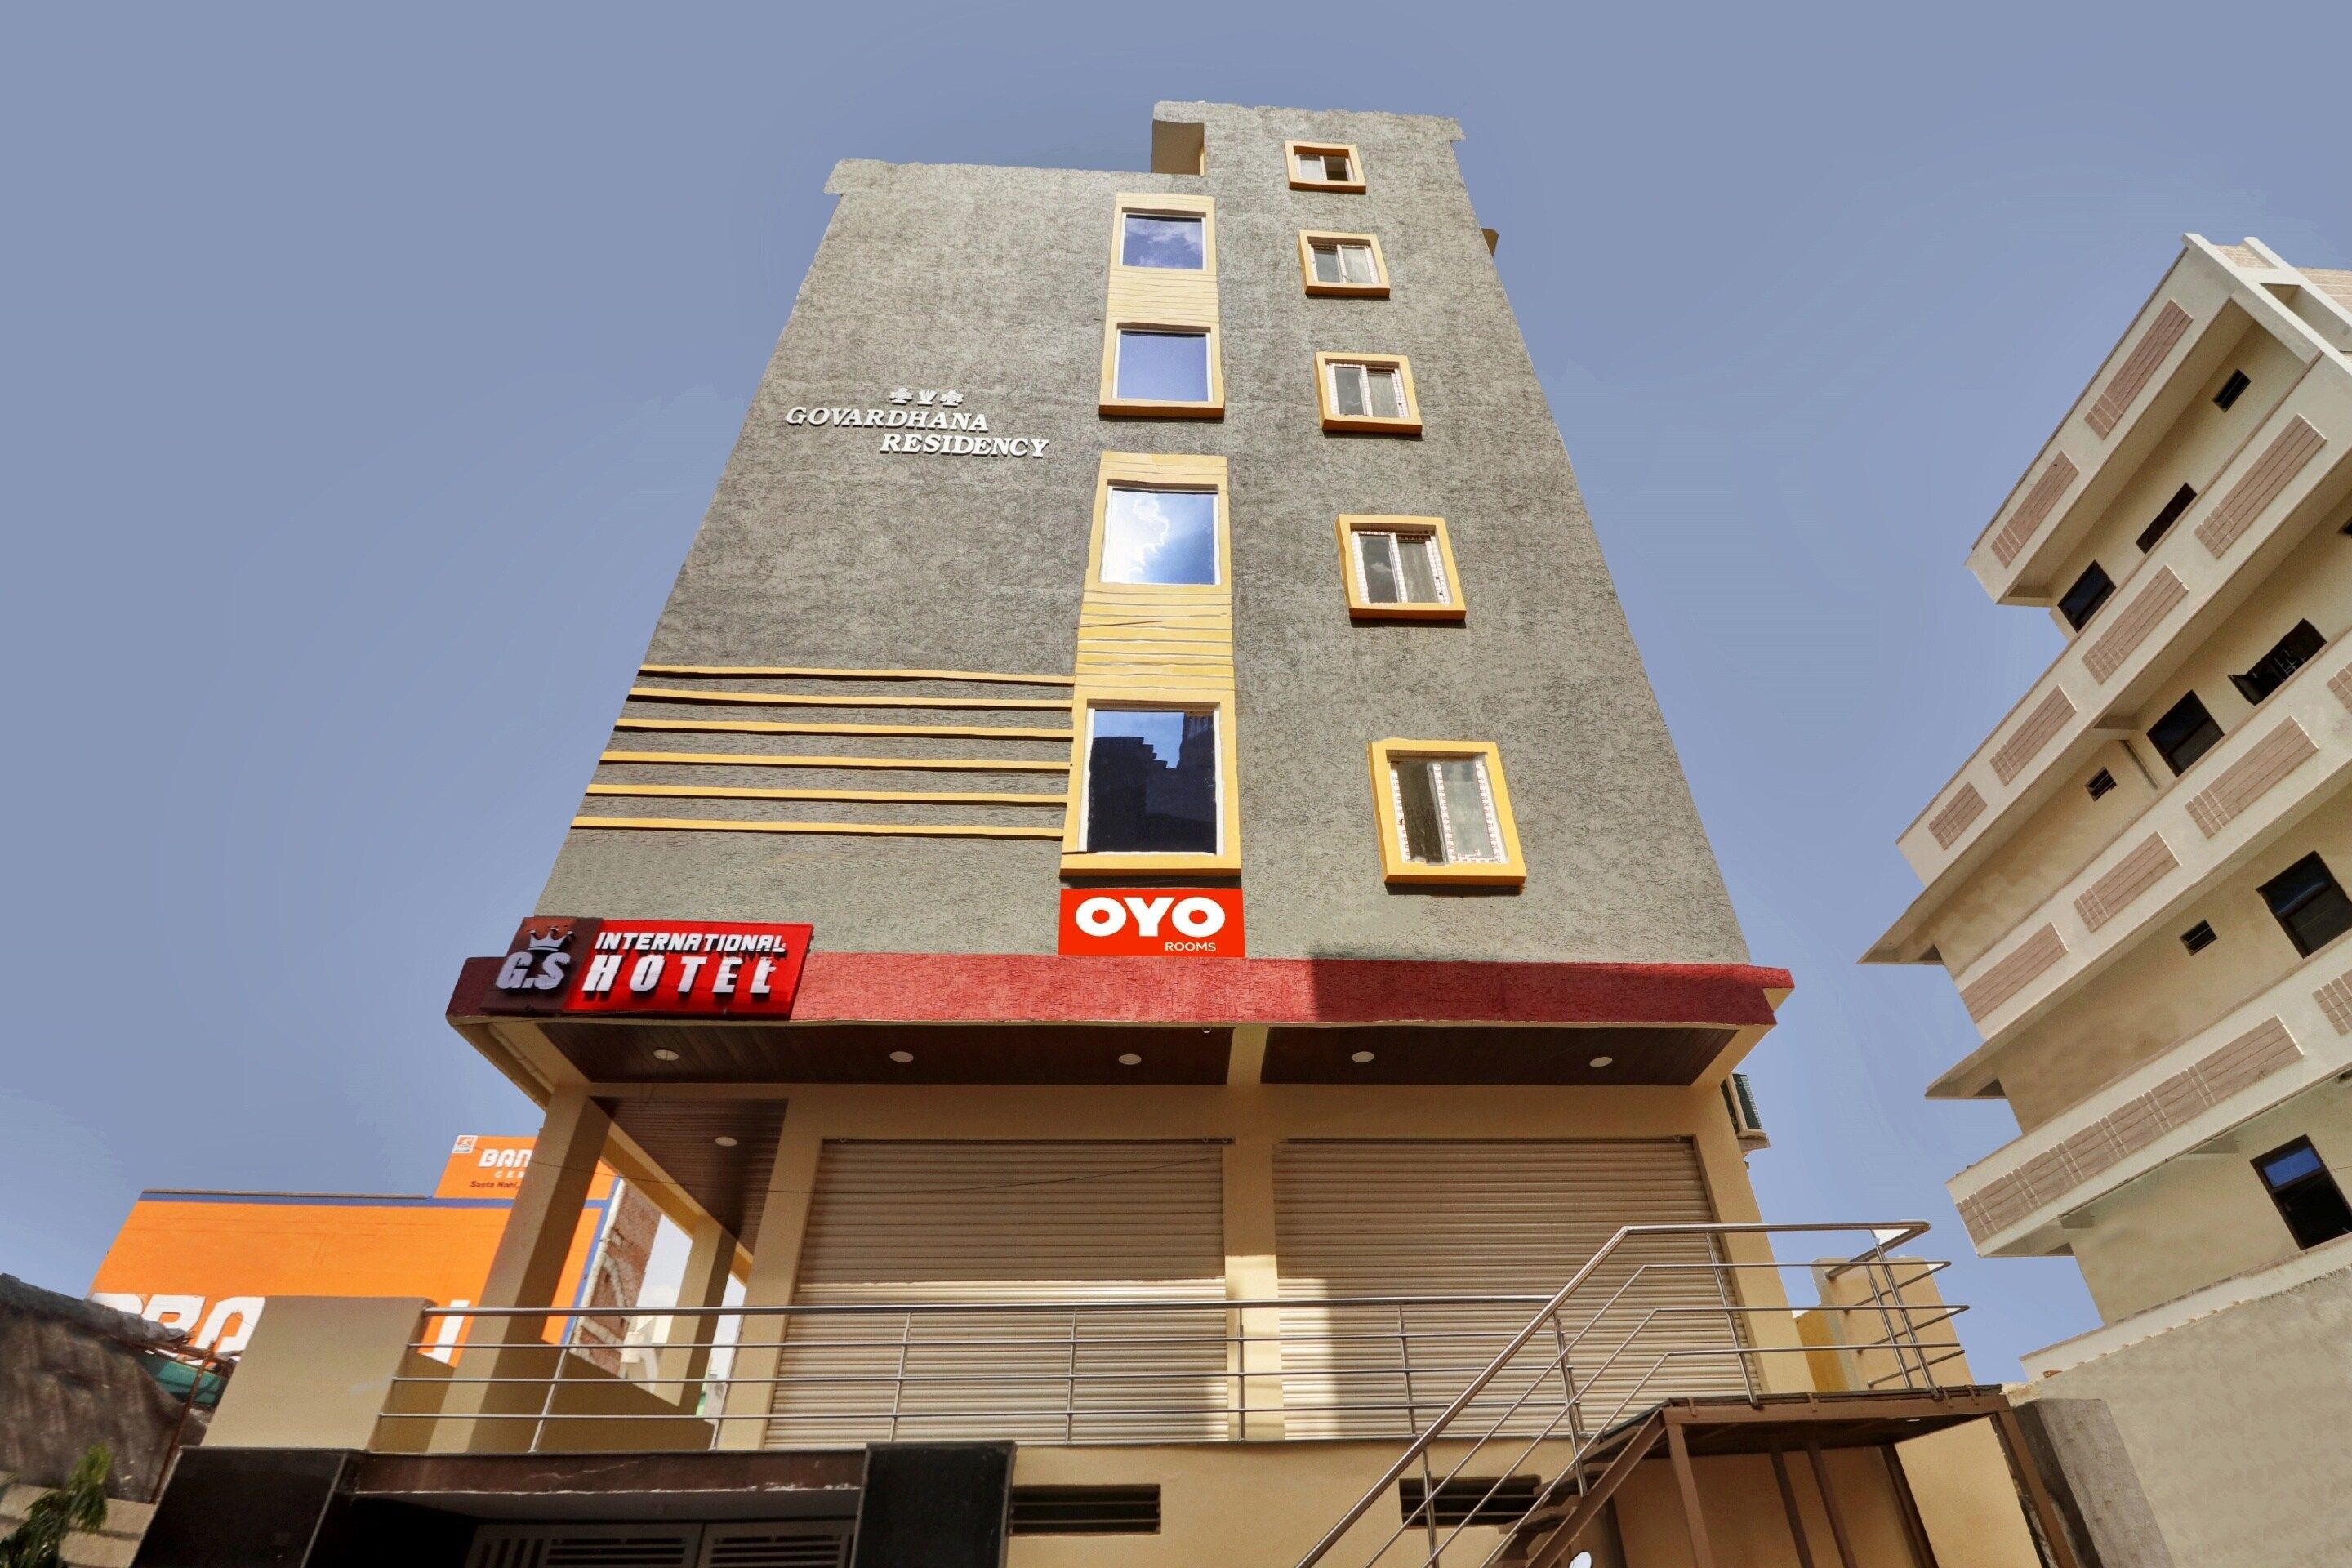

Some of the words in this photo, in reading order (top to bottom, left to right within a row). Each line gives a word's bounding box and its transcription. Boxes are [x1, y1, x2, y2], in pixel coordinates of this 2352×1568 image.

[786, 407, 989, 432] GOVARDHANA
[880, 433, 1050, 457] RESIDENCY
[1075, 896, 1226, 938] OYO
[595, 932, 786, 952] INTERNATIONAL
[1165, 942, 1216, 951] ROOMS
[581, 954, 776, 994] HOTEL
